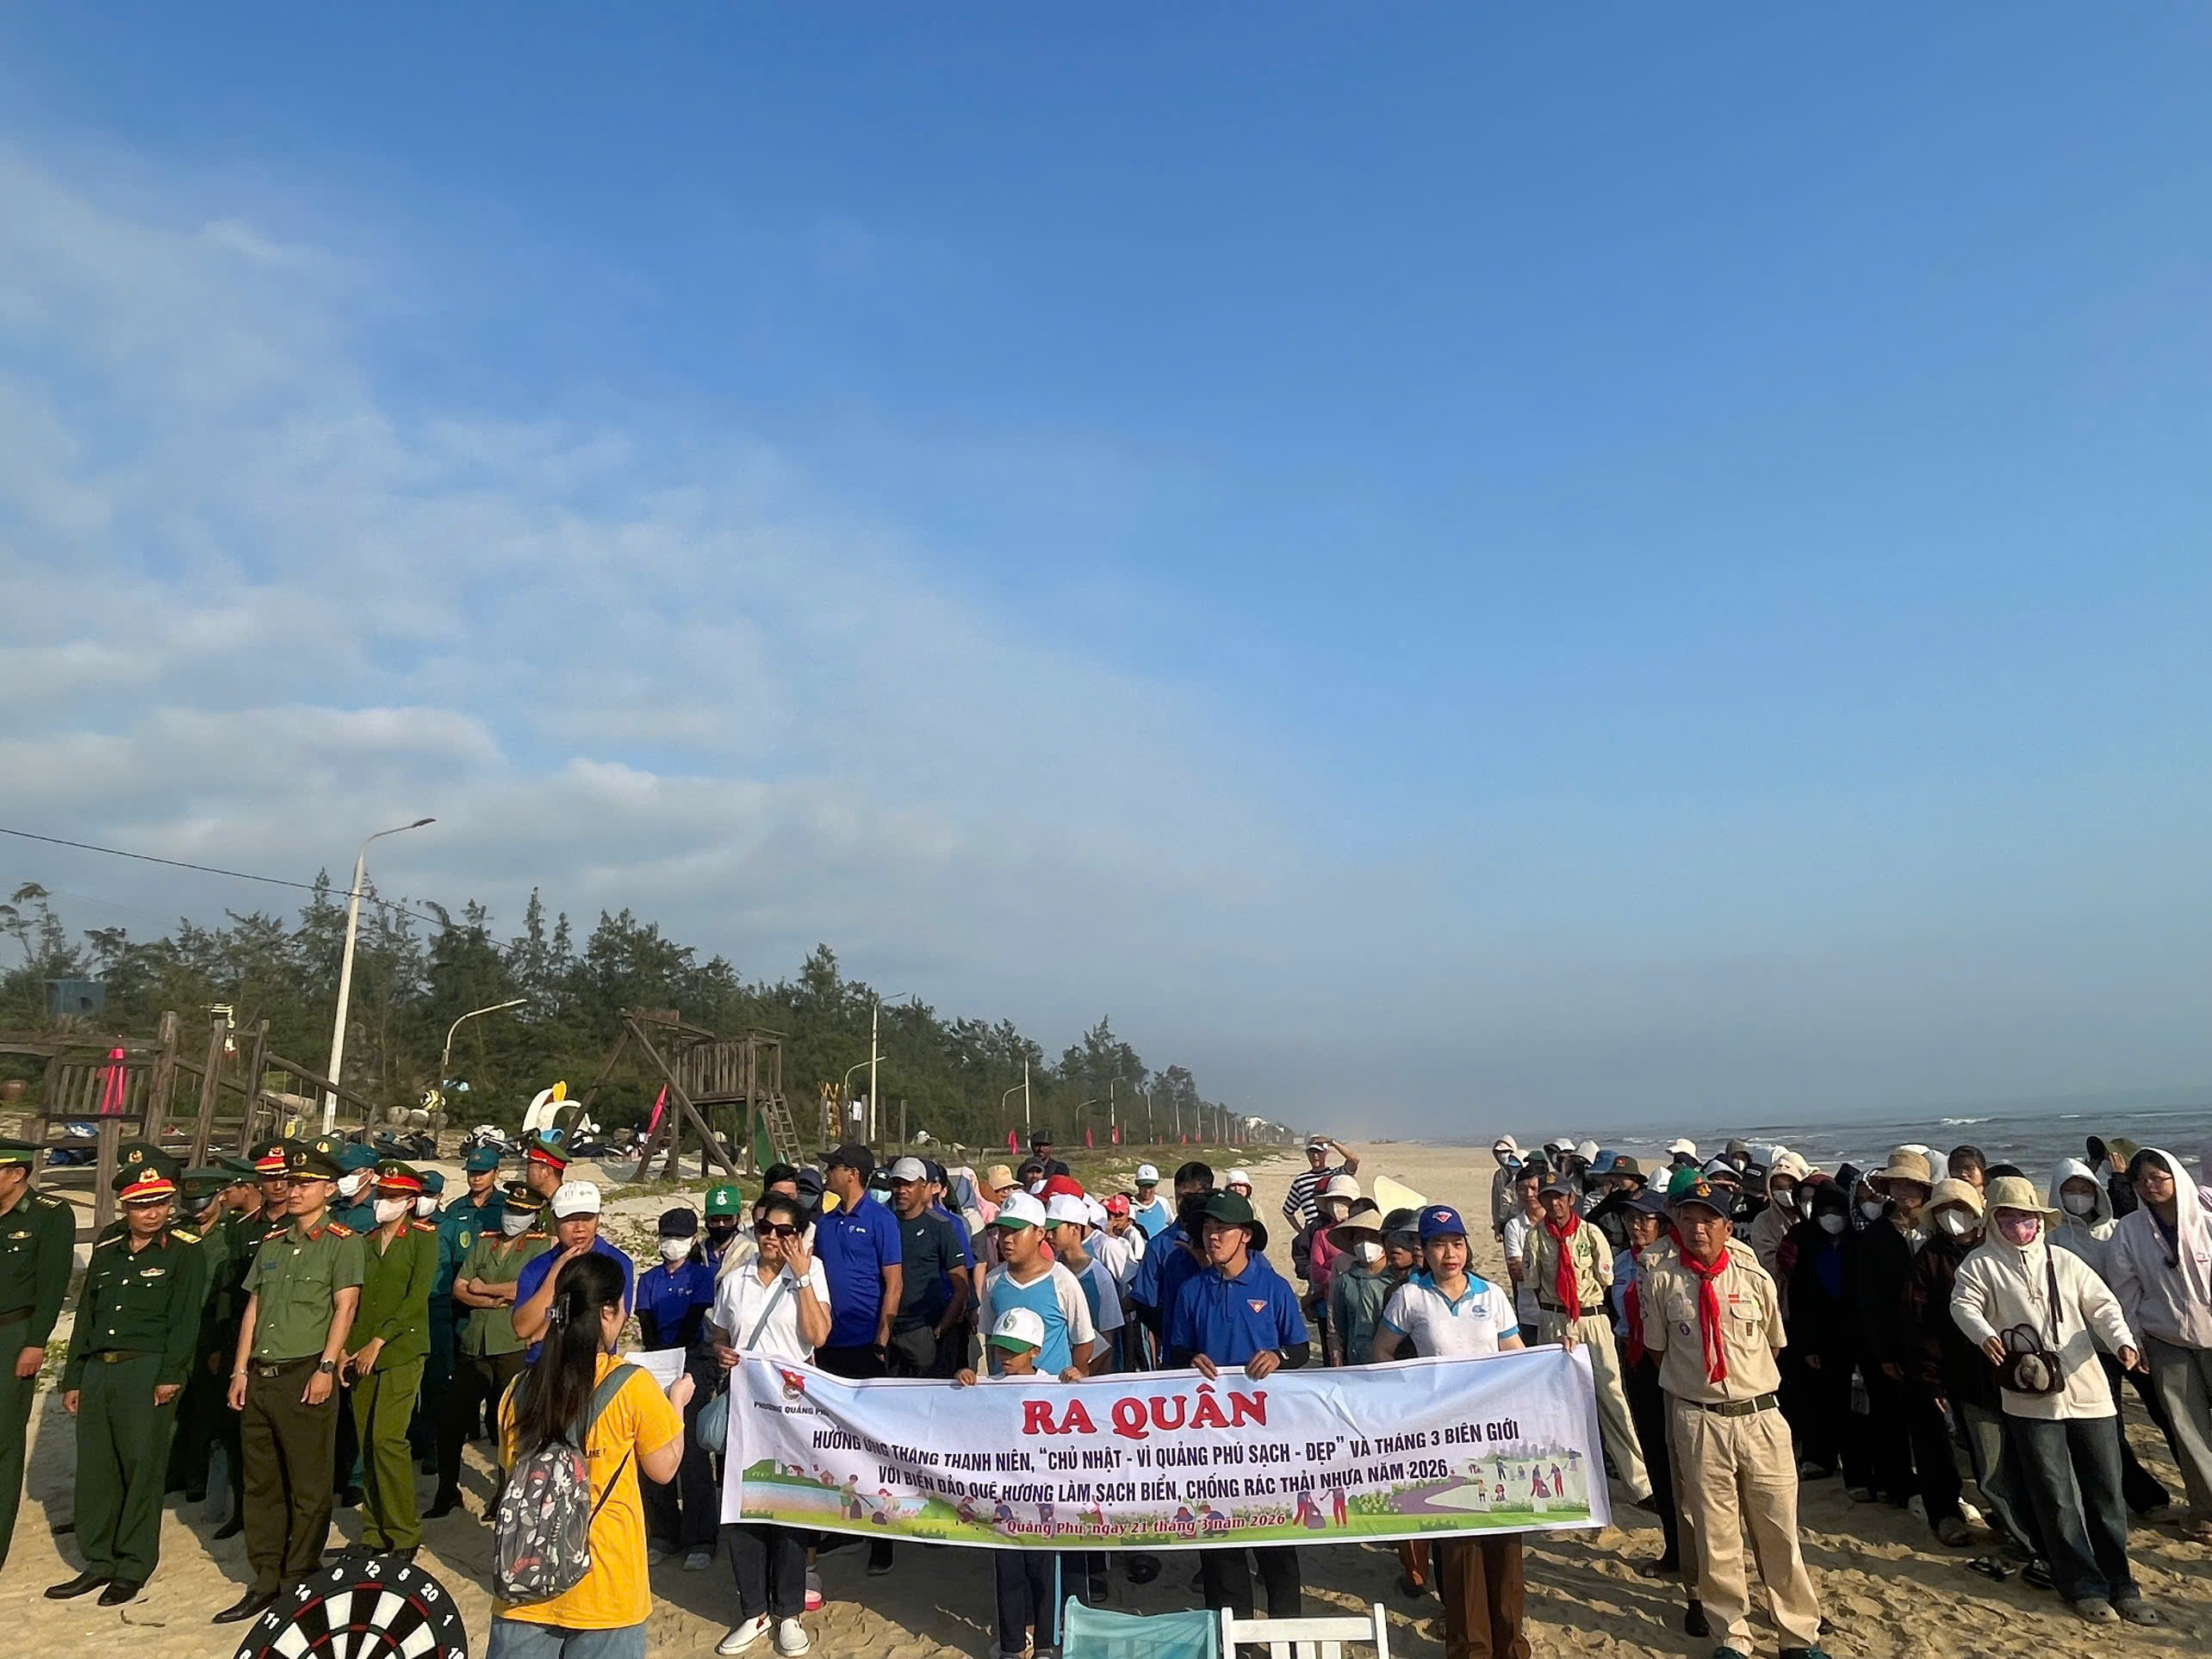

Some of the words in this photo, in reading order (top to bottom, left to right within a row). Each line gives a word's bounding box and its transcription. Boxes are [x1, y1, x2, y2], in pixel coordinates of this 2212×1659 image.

[1022, 1399, 1097, 1434] RA
[1111, 1382, 1268, 1440] QUÂN
[813, 1426, 861, 1450] HƯỞNG
[892, 1445, 938, 1466] THÁNG
[944, 1453, 991, 1471] THANH
[996, 1449, 1035, 1473] NIÊN,
[1083, 1446, 1122, 1473] NHẬT
[1137, 1445, 1151, 1467] VÌ
[1156, 1441, 1208, 1468] QUẢNG
[1213, 1441, 1243, 1465] PHÚ
[1249, 1444, 1290, 1468] SẠCH
[1350, 1436, 1371, 1458] VÀ
[1375, 1432, 1426, 1455] THÁNG
[1431, 1430, 1440, 1446] 3
[1445, 1422, 1482, 1445] BIÊN
[1487, 1417, 1519, 1441] GIỚI
[879, 1463, 901, 1484] VỚI
[904, 1469, 935, 1491] BIỂN
[938, 1475, 965, 1497] ĐẢO
[969, 1482, 997, 1500] QUÊ
[1002, 1483, 1053, 1502] HƯƠNG
[1059, 1480, 1090, 1502] LÀM
[1096, 1482, 1135, 1507] SẠCH
[1141, 1474, 1182, 1502] BIỂN,
[1186, 1472, 1240, 1500] CHỐNG
[1244, 1474, 1276, 1496] RÁC
[1280, 1469, 1315, 1493] THẢI
[1320, 1468, 1364, 1490] NHỰA
[1368, 1462, 1404, 1482] NĂM
[1408, 1458, 1448, 1480] 2026
[1134, 1522, 1147, 1533] 21
[1201, 1519, 1209, 1531] 3
[1213, 1517, 1245, 1530] năm
[1250, 1513, 1285, 1526] 2026
[332, 1568, 344, 1581] 9
[365, 1560, 382, 1579] 12
[398, 1568, 411, 1581] 5
[295, 1583, 311, 1601] 14
[420, 1582, 438, 1602] 20
[264, 1612, 280, 1630] 11
[443, 1614, 454, 1627] 1
